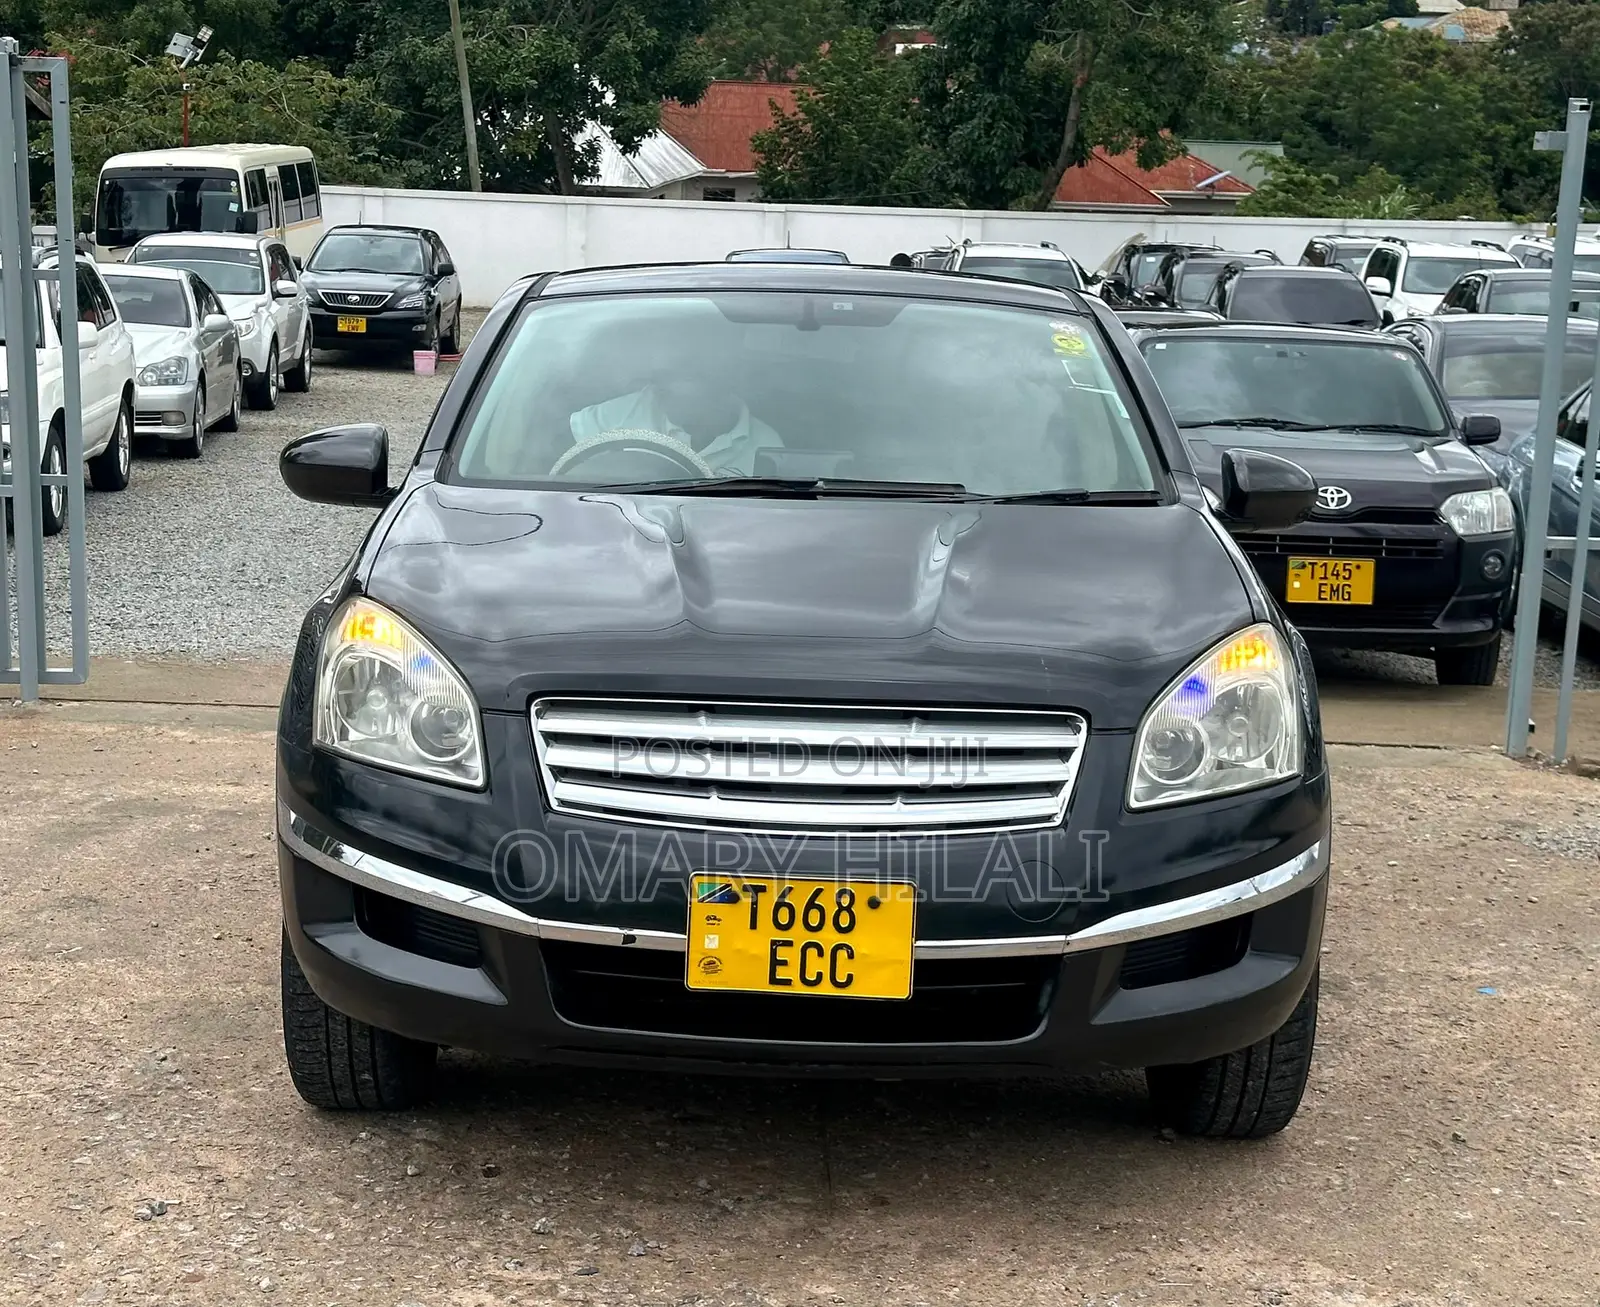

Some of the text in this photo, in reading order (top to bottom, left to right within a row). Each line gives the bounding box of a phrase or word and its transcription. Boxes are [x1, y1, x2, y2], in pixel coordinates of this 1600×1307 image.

[1308, 562, 1353, 580] T145
[1318, 583, 1352, 601] EMG
[742, 884, 856, 934] T668
[768, 939, 855, 988] ECC
